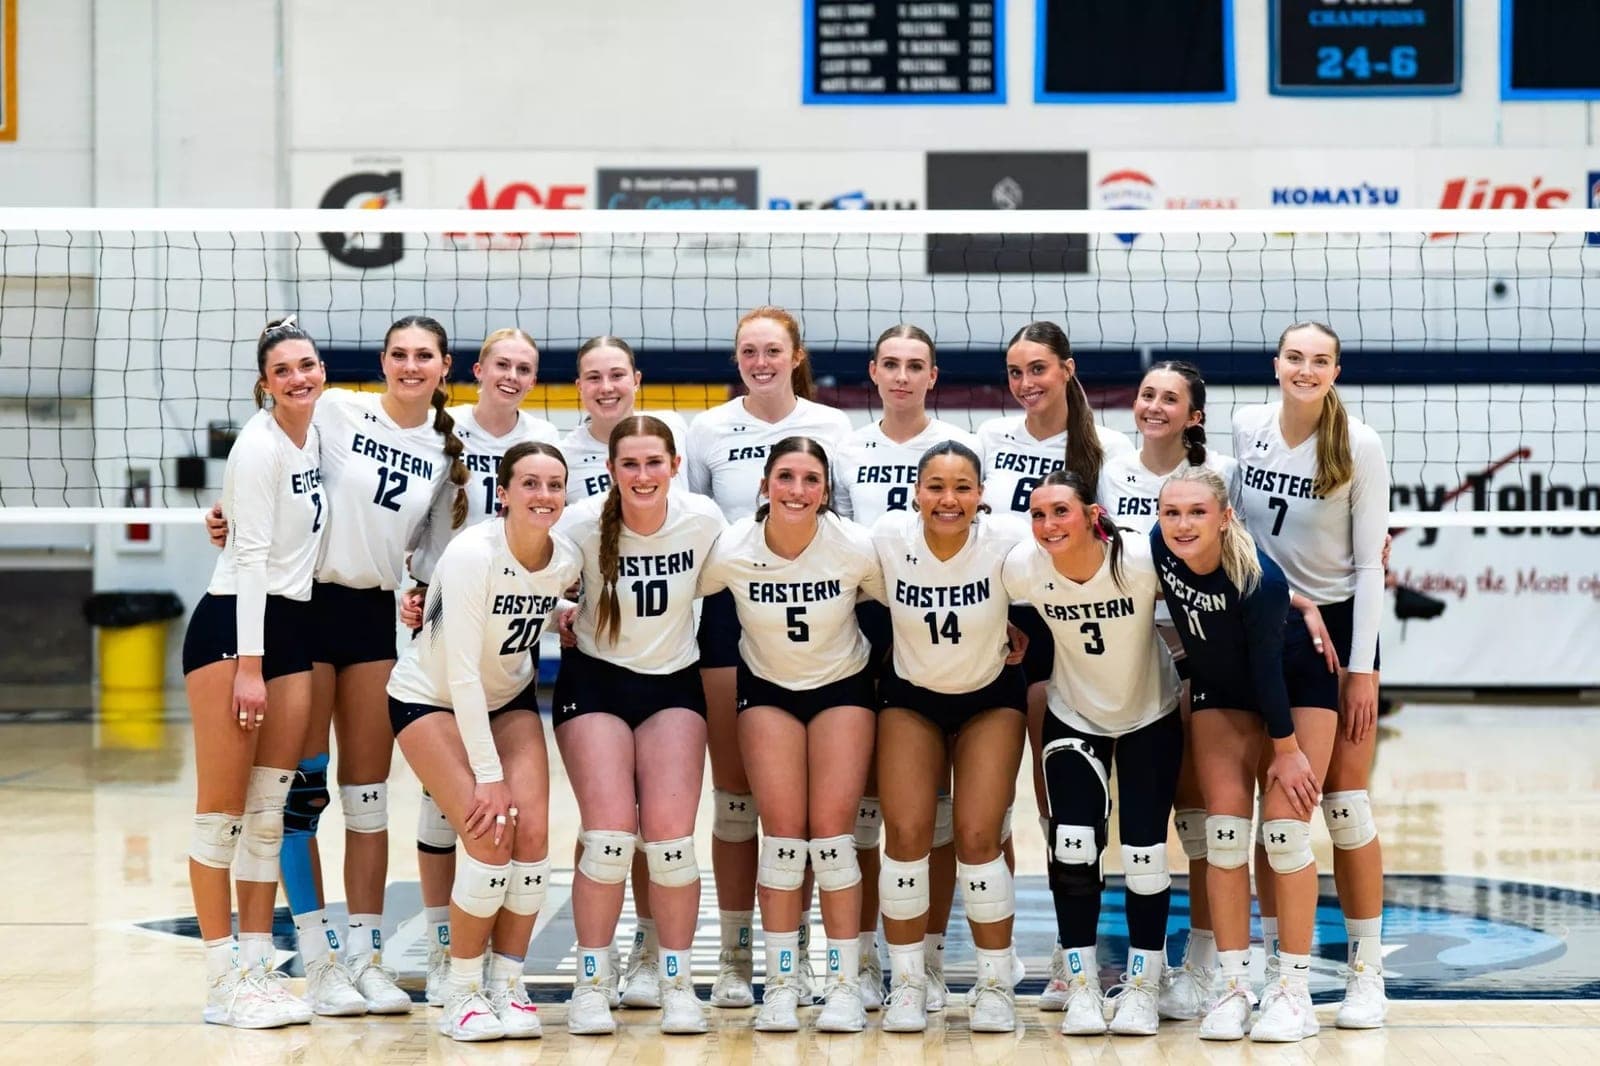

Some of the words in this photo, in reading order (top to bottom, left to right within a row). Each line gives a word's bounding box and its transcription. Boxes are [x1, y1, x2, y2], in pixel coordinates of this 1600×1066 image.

[1316, 46, 1418, 79] 24-6
[1272, 182, 1400, 205] KOMATSU
[351, 433, 433, 481] EASTERN
[373, 466, 408, 512] 12
[1268, 496, 1288, 536] 7
[631, 579, 668, 617] 10
[749, 579, 841, 603] EASTERN
[896, 577, 990, 608] EASTERN
[1043, 596, 1135, 621] EASTERN
[499, 617, 545, 655] 20
[786, 606, 809, 642] 5
[924, 611, 961, 645] 14
[1079, 622, 1105, 655] 3
[1182, 604, 1207, 641] 11
